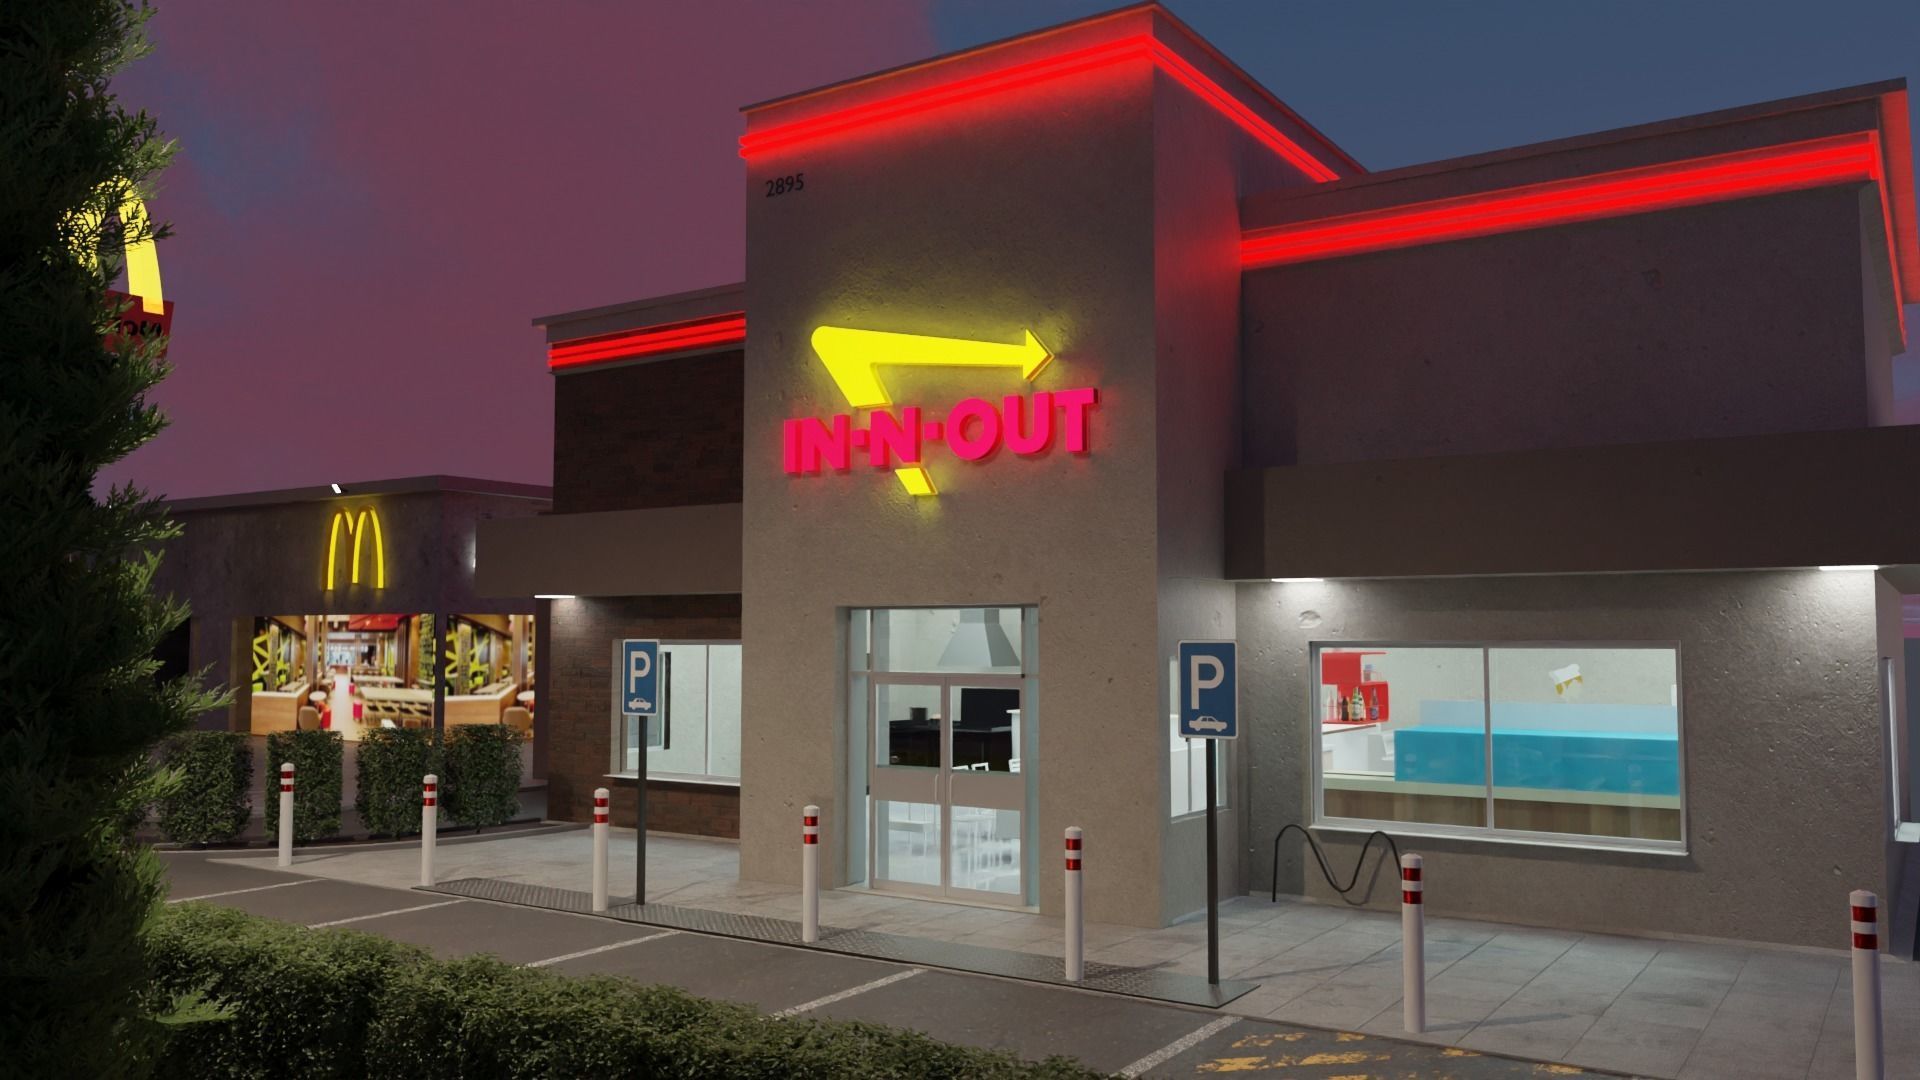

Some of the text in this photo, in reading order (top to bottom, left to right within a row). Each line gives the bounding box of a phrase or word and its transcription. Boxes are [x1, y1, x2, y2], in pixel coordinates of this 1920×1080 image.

[766, 173, 805, 198] 2895
[629, 650, 651, 694] P
[1190, 654, 1225, 710] P
